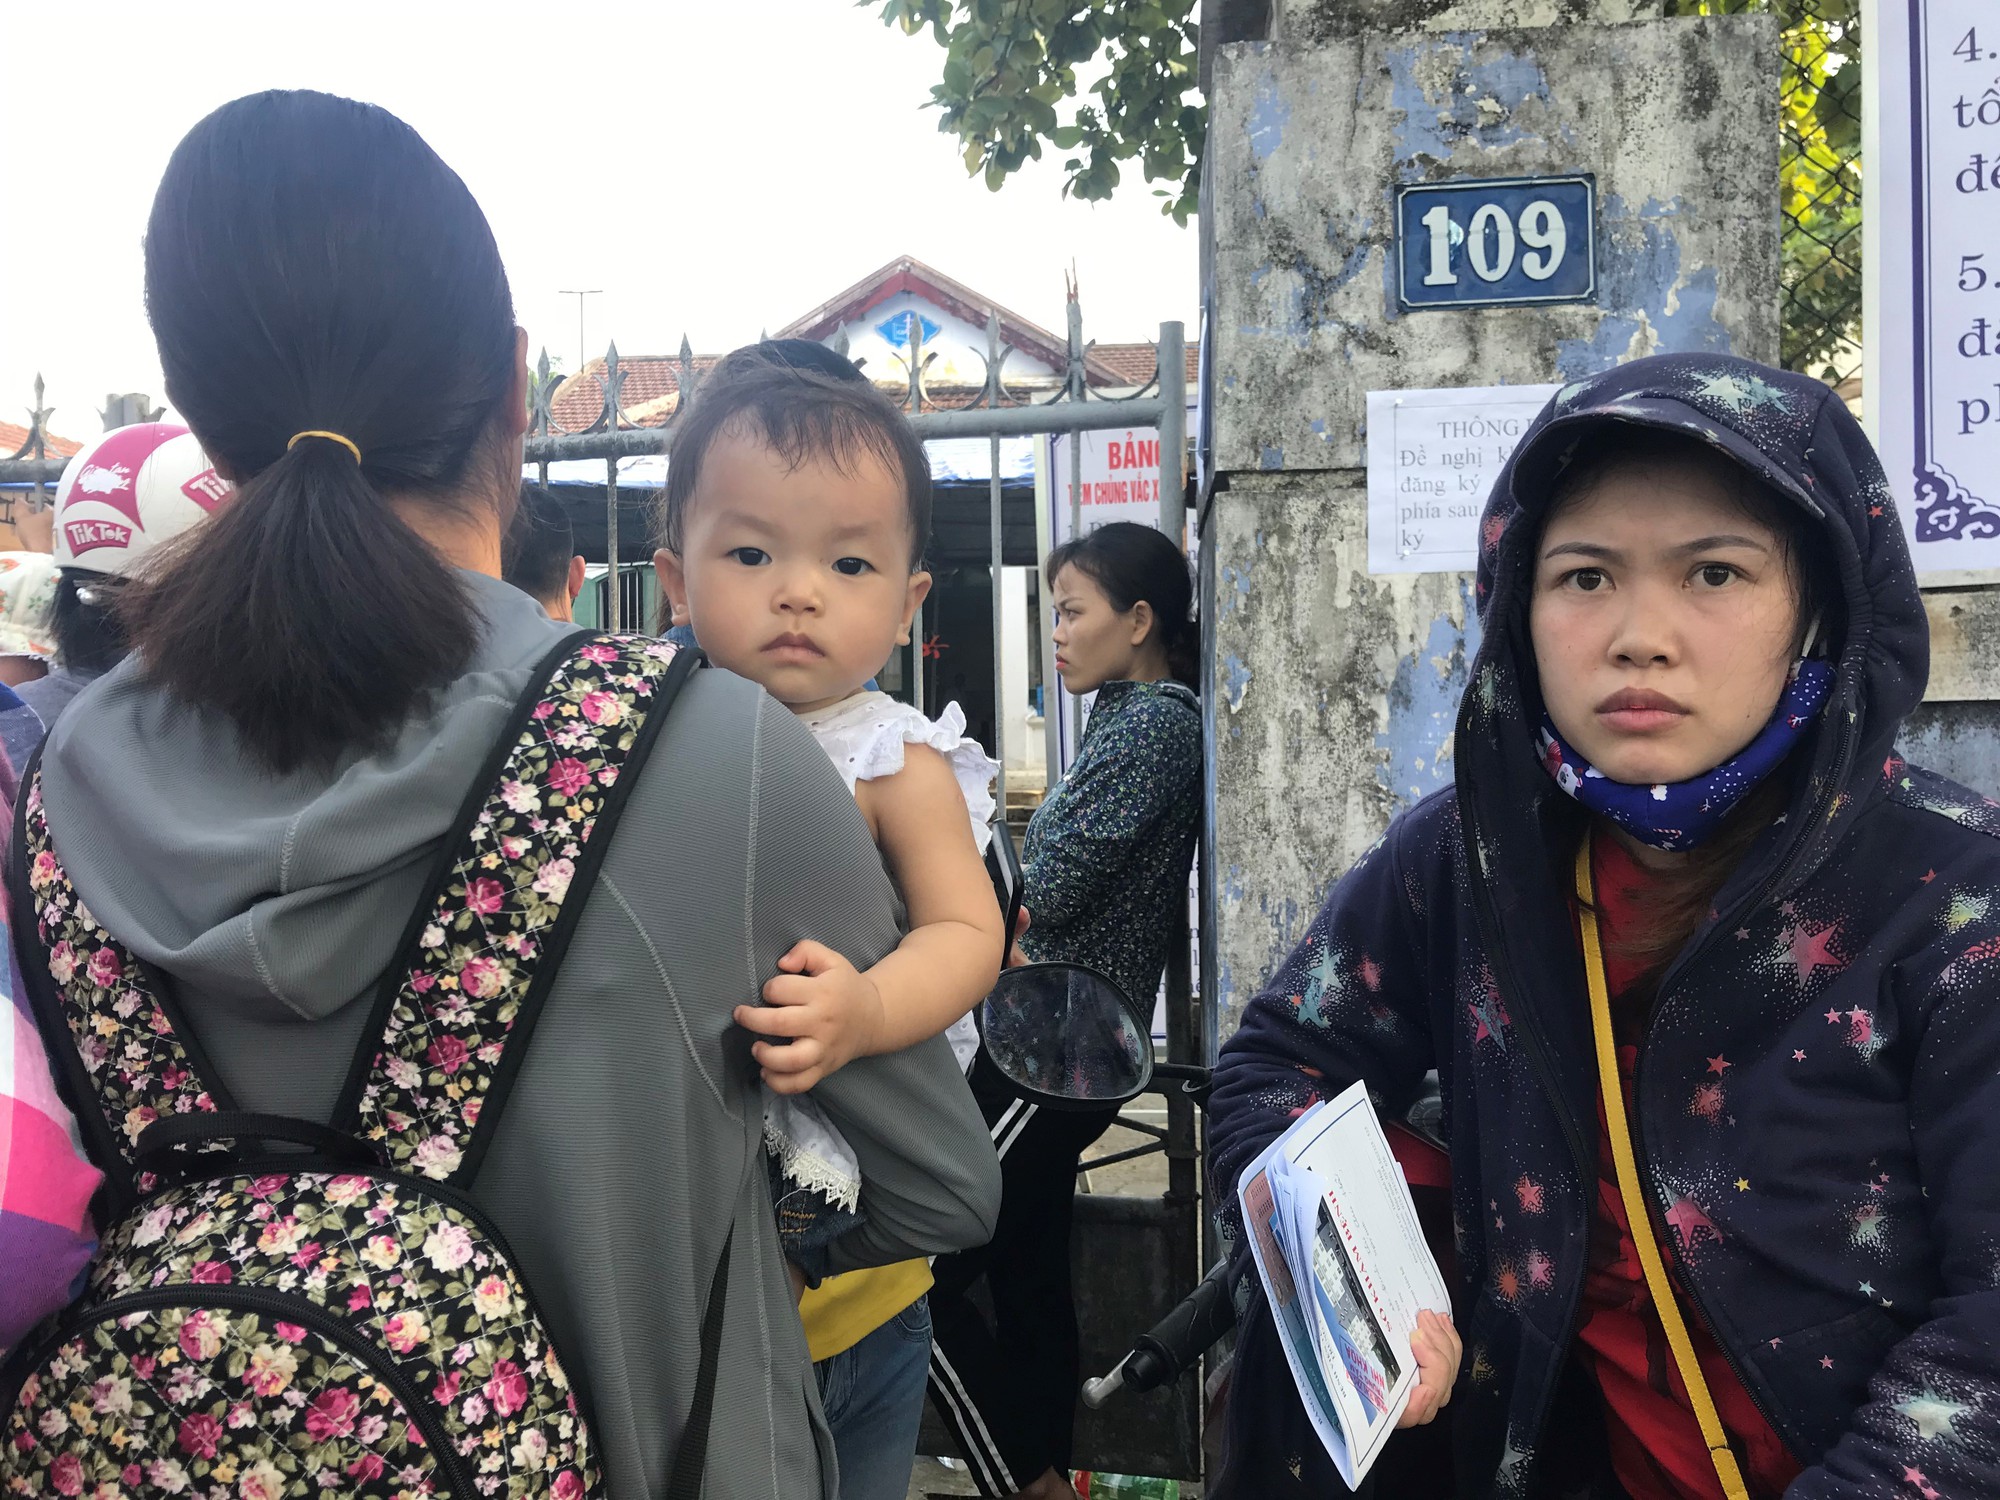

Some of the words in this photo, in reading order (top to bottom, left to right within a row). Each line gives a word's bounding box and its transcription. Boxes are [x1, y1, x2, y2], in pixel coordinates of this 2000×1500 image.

[1953, 26, 1998, 63] 4.
[1422, 200, 1566, 286] 109
[1958, 253, 2000, 292] 5.
[1958, 317, 2000, 358] đ
[1437, 415, 1519, 438] THÔNG
[1441, 446, 1482, 470] nghị
[1400, 475, 1446, 496] đăng
[1458, 474, 1481, 495] ký
[1401, 501, 1441, 524] phía
[1448, 504, 1479, 518] sau
[1402, 528, 1424, 550] ký
